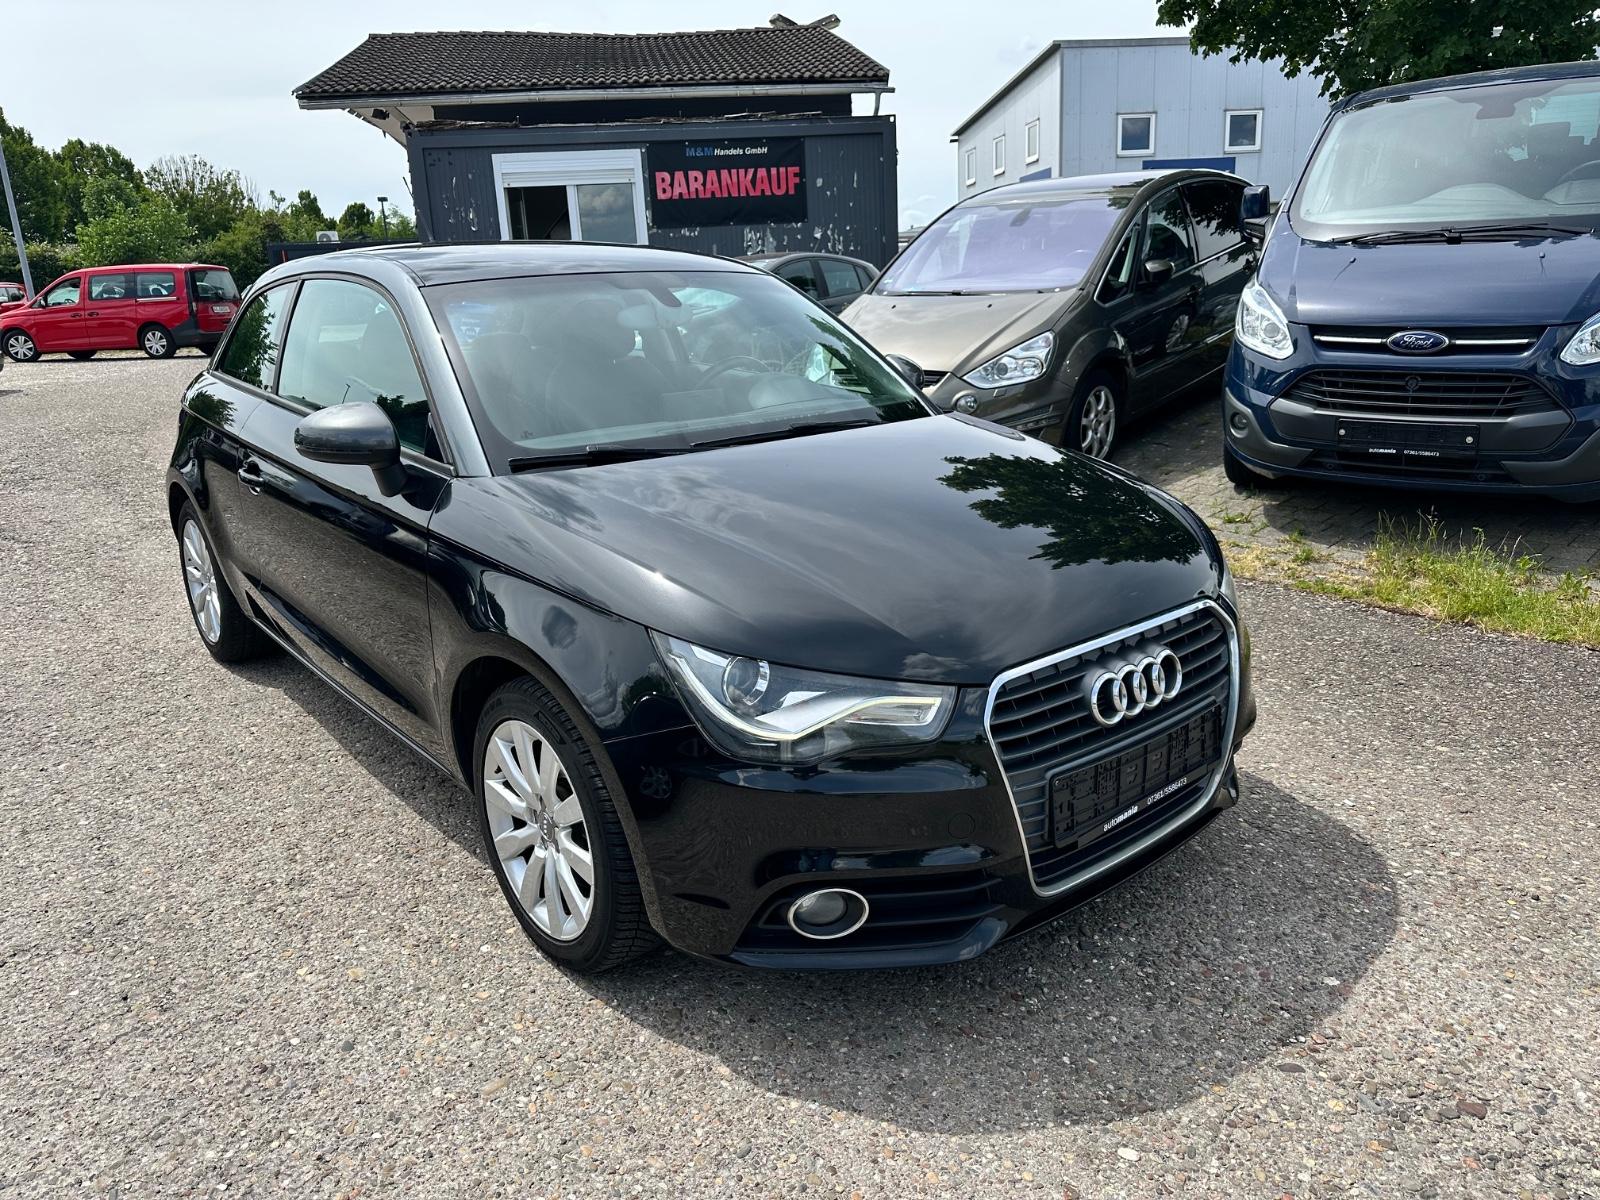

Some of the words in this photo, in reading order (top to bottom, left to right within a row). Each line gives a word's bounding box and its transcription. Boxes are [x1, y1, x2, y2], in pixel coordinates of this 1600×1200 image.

[685, 147, 714, 157] M&M
[714, 147, 744, 156] Handels
[744, 146, 768, 155] GmbH
[655, 166, 800, 200] BARANKAUF
[1400, 334, 1434, 347] Ford
[1103, 805, 1138, 832] automania
[1146, 777, 1187, 805] 07361/5586473
